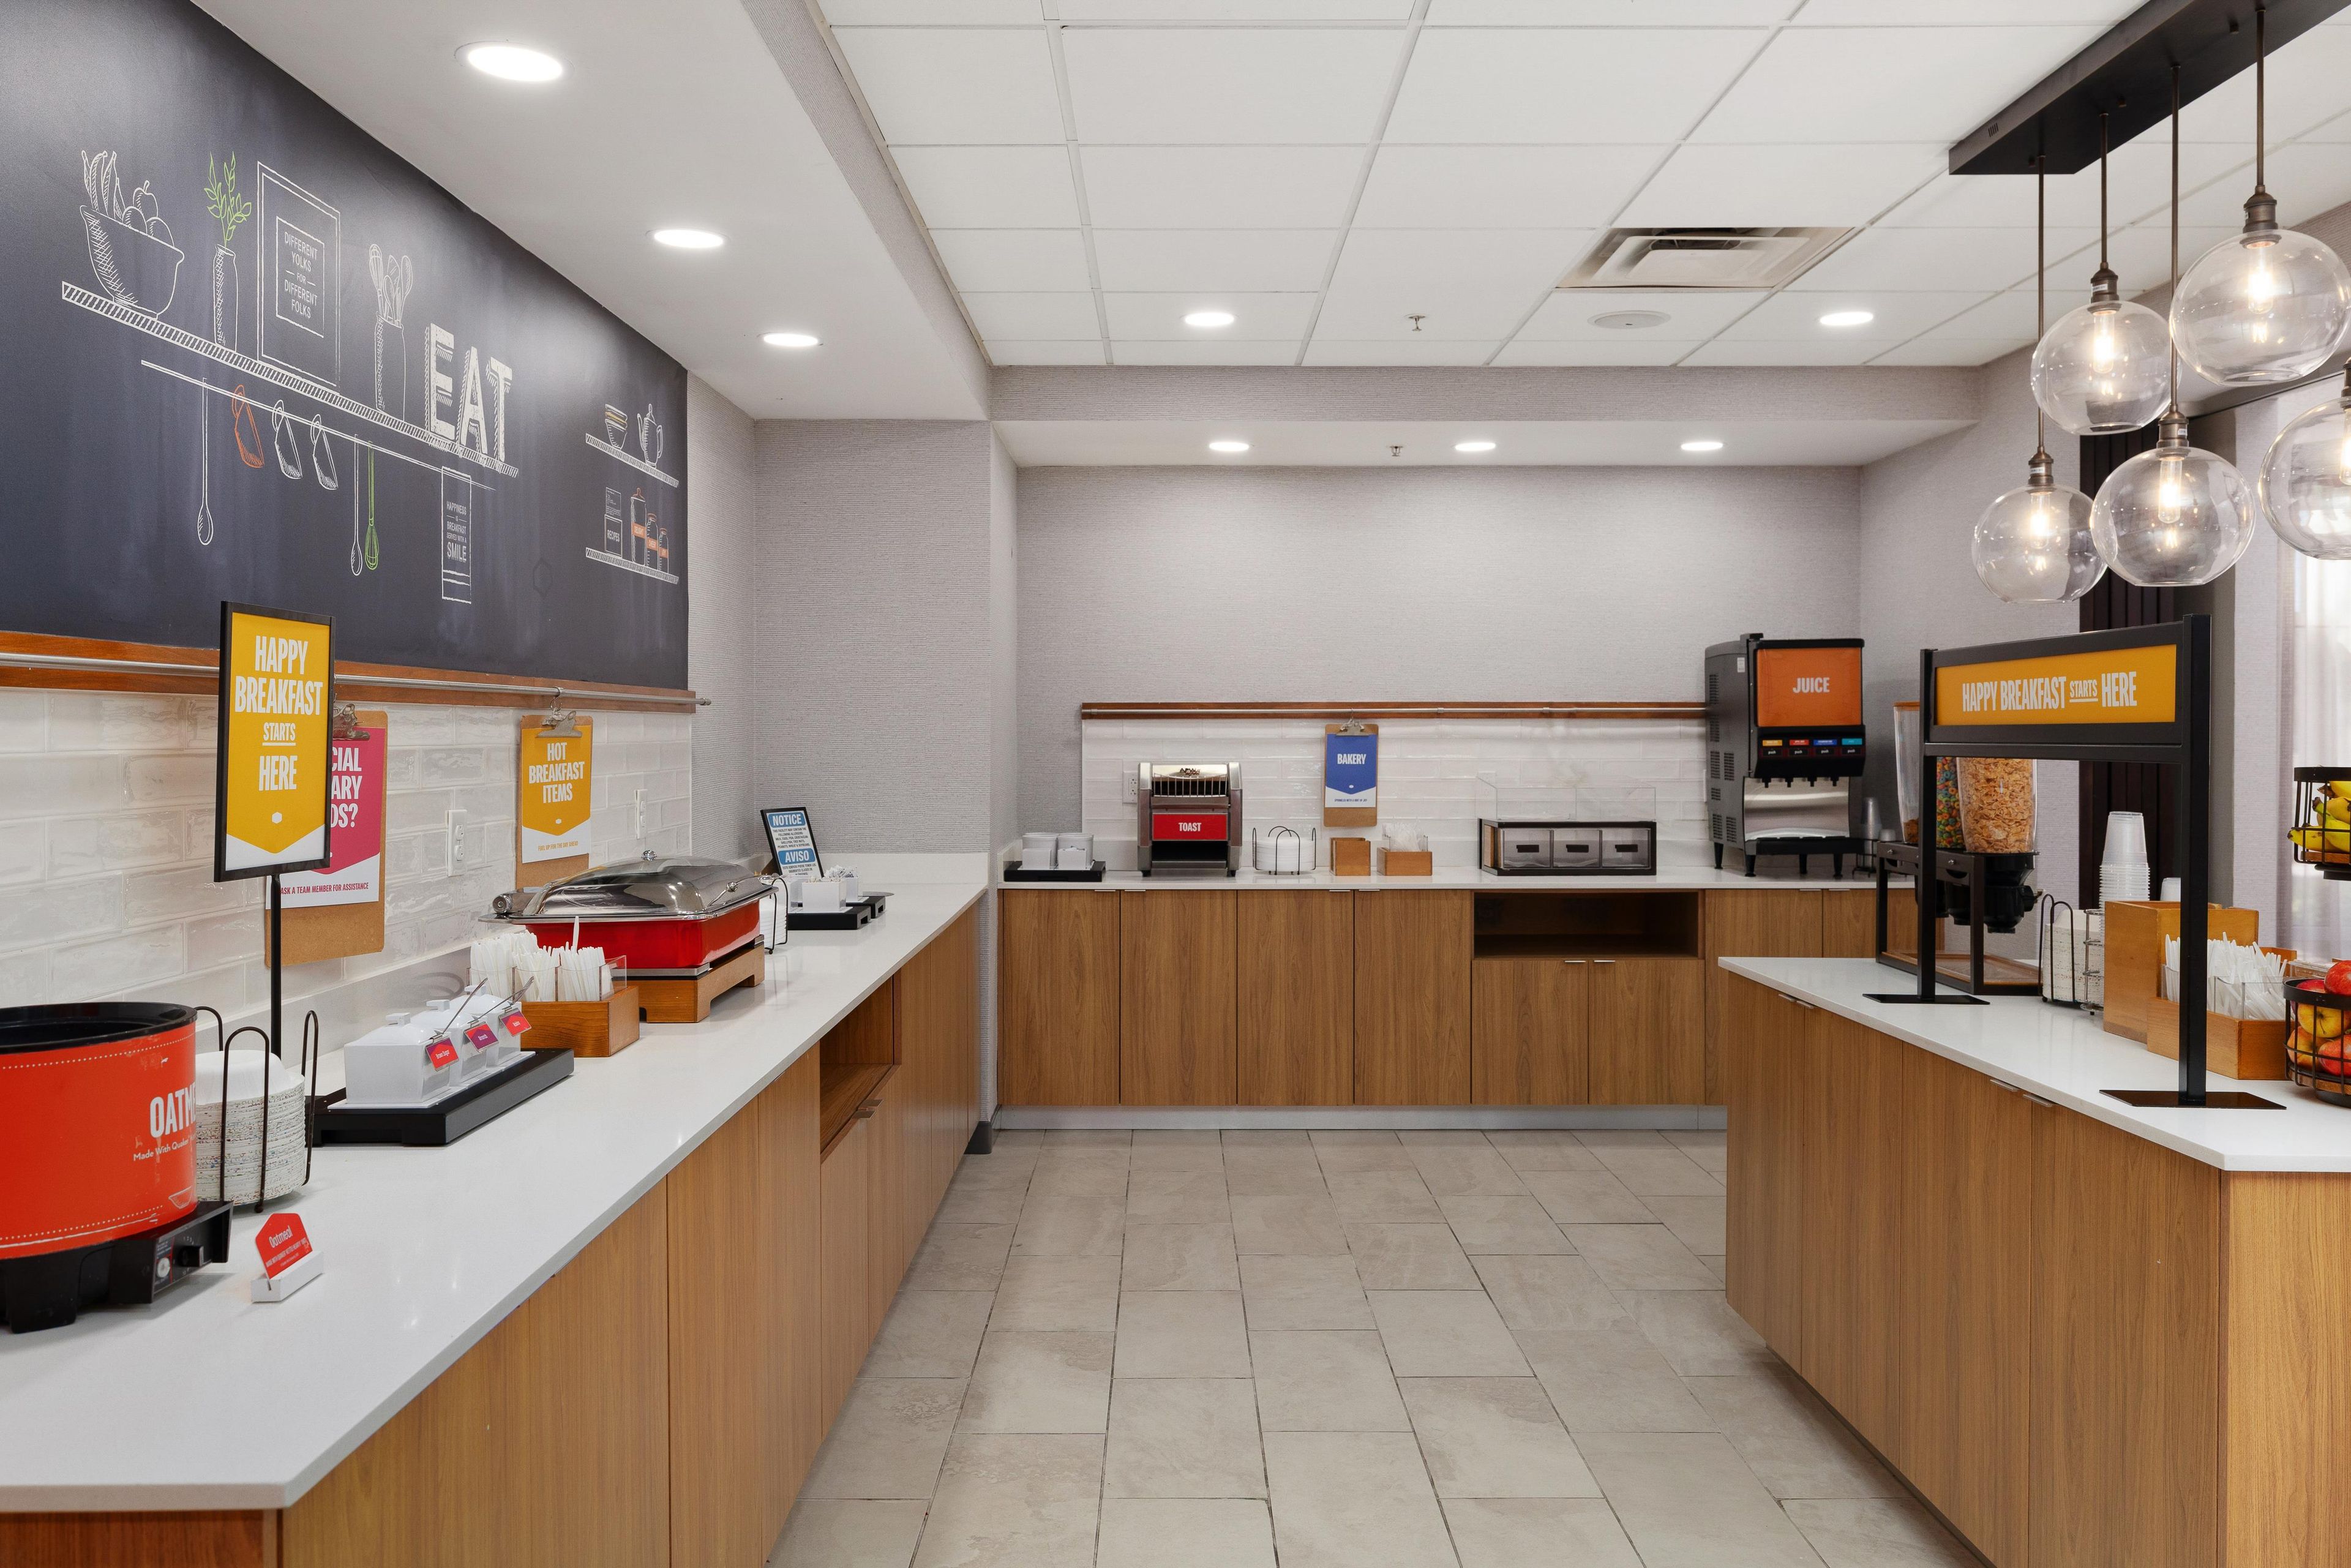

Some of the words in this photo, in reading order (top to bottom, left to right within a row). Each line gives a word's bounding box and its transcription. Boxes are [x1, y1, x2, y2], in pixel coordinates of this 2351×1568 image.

[285, 231, 318, 260] DIFFERENT
[291, 251, 312, 272] YOLKS
[296, 272, 306, 284] FOR
[284, 279, 318, 306] DIFFERENT
[291, 299, 311, 319] FOLKS
[427, 323, 512, 462] EAT
[446, 501, 467, 515] HAPPINESS
[447, 521, 467, 534] BREAKFAST
[607, 529, 620, 542] RECIPES
[447, 541, 467, 563] SMILE
[255, 635, 309, 675] HAPPY
[234, 675, 323, 716] BREAKFAST
[1793, 677, 1830, 693] JUICE
[1962, 681, 1998, 712] HAPPY
[2000, 676, 2067, 711] BREAKFAST
[2069, 679, 2098, 698] STARTS
[2101, 671, 2137, 708] HERE
[263, 722, 296, 741] STARTS
[332, 746, 362, 772] CIAL
[547, 742, 568, 762] HOT
[1337, 753, 1367, 765] BAKERY
[258, 755, 298, 791] HERE
[528, 761, 585, 784] BREAKFAST
[542, 782, 573, 804] ITEMS
[331, 803, 359, 828] DS?
[773, 814, 802, 826] NOTICE
[1179, 822, 1202, 832] TOAST
[785, 850, 809, 863] AVISO
[342, 882, 369, 891] ASSISTANCE
[133, 1149, 154, 1161] Made
[155, 1143, 171, 1155] With
[171, 1138, 189, 1150] Quaker
[269, 1225, 293, 1248] Oatmeal
